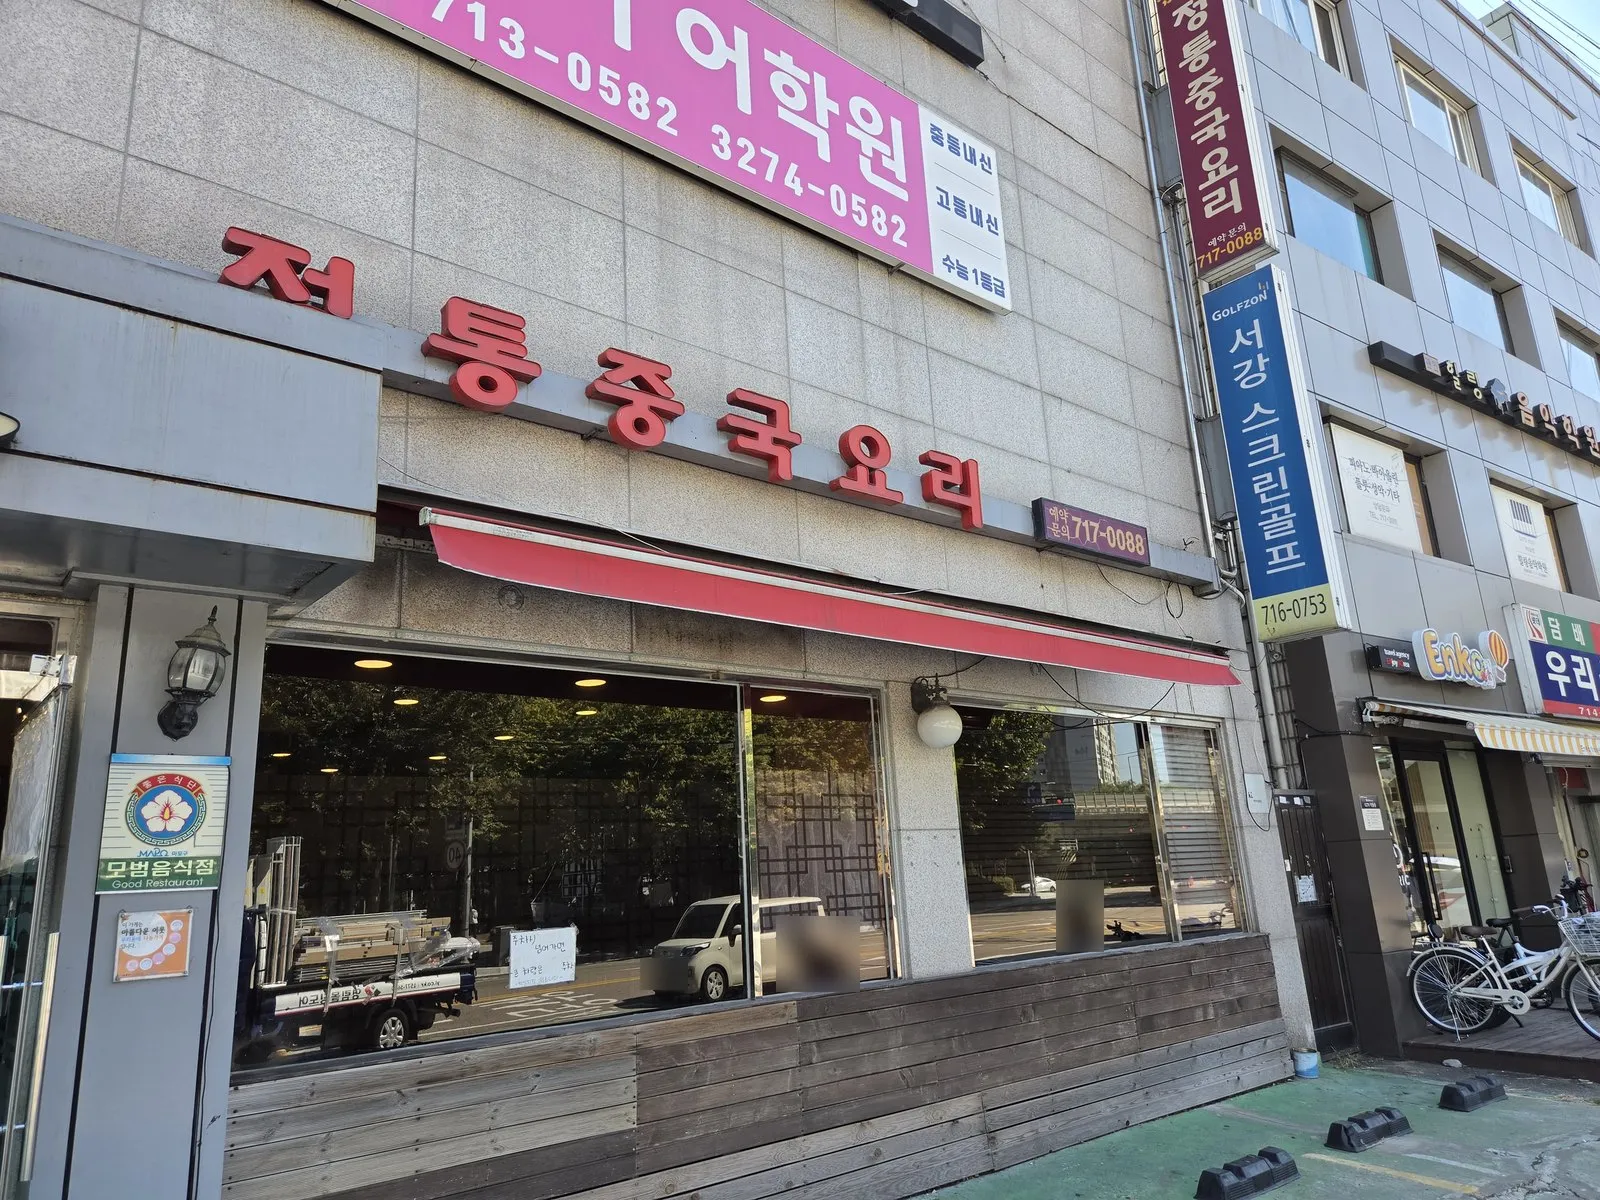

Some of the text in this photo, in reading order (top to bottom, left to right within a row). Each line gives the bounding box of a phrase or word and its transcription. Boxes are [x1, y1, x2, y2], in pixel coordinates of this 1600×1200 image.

[432, 0, 907, 247] 713-0582 3274-0582
[1172, 0, 1243, 219] 정통중국요리
[930, 123, 993, 175] 중등내신
[935, 185, 999, 236] 고등내신
[1197, 227, 1263, 268] 717-0088
[1207, 233, 1226, 247] 예약
[1211, 289, 1268, 322] GOLFZON
[1516, 391, 1600, 459] 음악학원
[1049, 505, 1069, 523] 예약
[1051, 521, 1070, 541] 문의
[1072, 516, 1145, 556] 717-0088
[1261, 593, 1327, 626] 716-0753
[1545, 651, 1600, 701] 우리
[105, 859, 214, 878] 모범음식점
[112, 877, 204, 889] Good Restaurant
[121, 927, 149, 936] 아름다운
